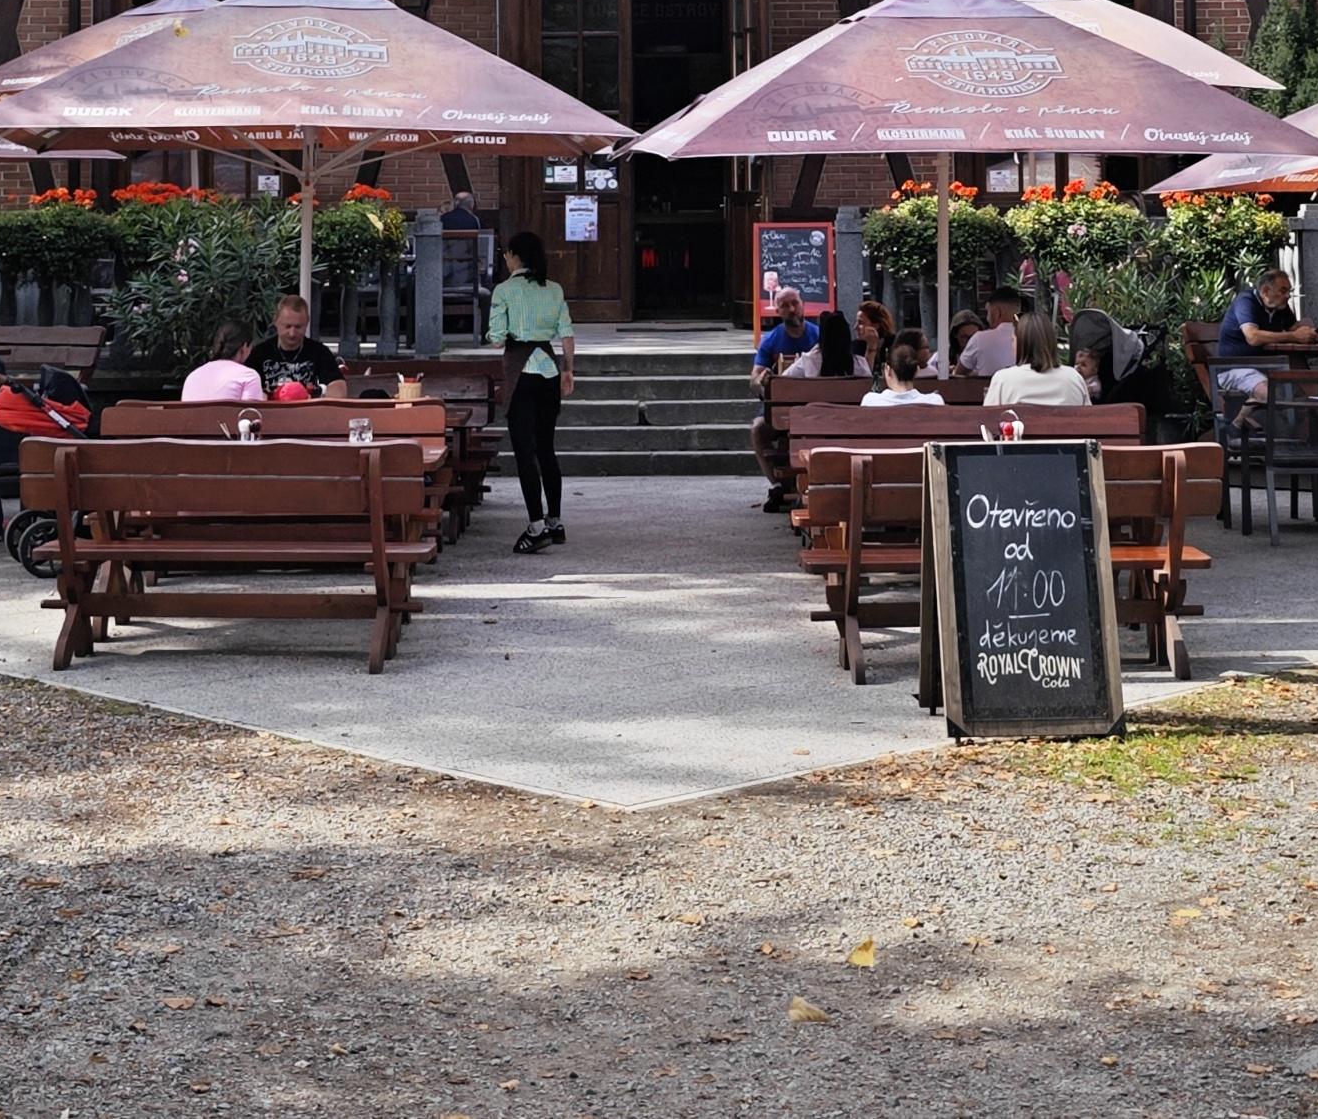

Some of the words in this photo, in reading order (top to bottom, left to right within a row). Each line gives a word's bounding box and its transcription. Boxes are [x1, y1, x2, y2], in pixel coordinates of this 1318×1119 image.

[265, 18, 356, 38] PIVOVAR
[927, 32, 1023, 49] PIVOVAR
[285, 53, 338, 65] 1649
[264, 61, 361, 77] STRAKONICE
[963, 69, 1016, 81] 1649
[944, 77, 1040, 96] STRAKONICE
[63, 105, 133, 117] DUDÁK
[174, 105, 261, 117] KLOSTERMANN
[301, 104, 337, 115] KRÁL
[341, 104, 404, 118] ŠUMAVY
[767, 129, 838, 142] DUDÁK
[877, 128, 966, 140] KLOSTERMANN
[1004, 126, 1042, 139] KRÁL
[1044, 126, 1106, 140] ŠUMAVY
[966, 494, 1076, 529] Otevřeno
[1004, 532, 1033, 560] od
[979, 619, 1079, 649] děkujeme
[977, 652, 1023, 685] ROYAL
[1042, 677, 1070, 689] Cola
